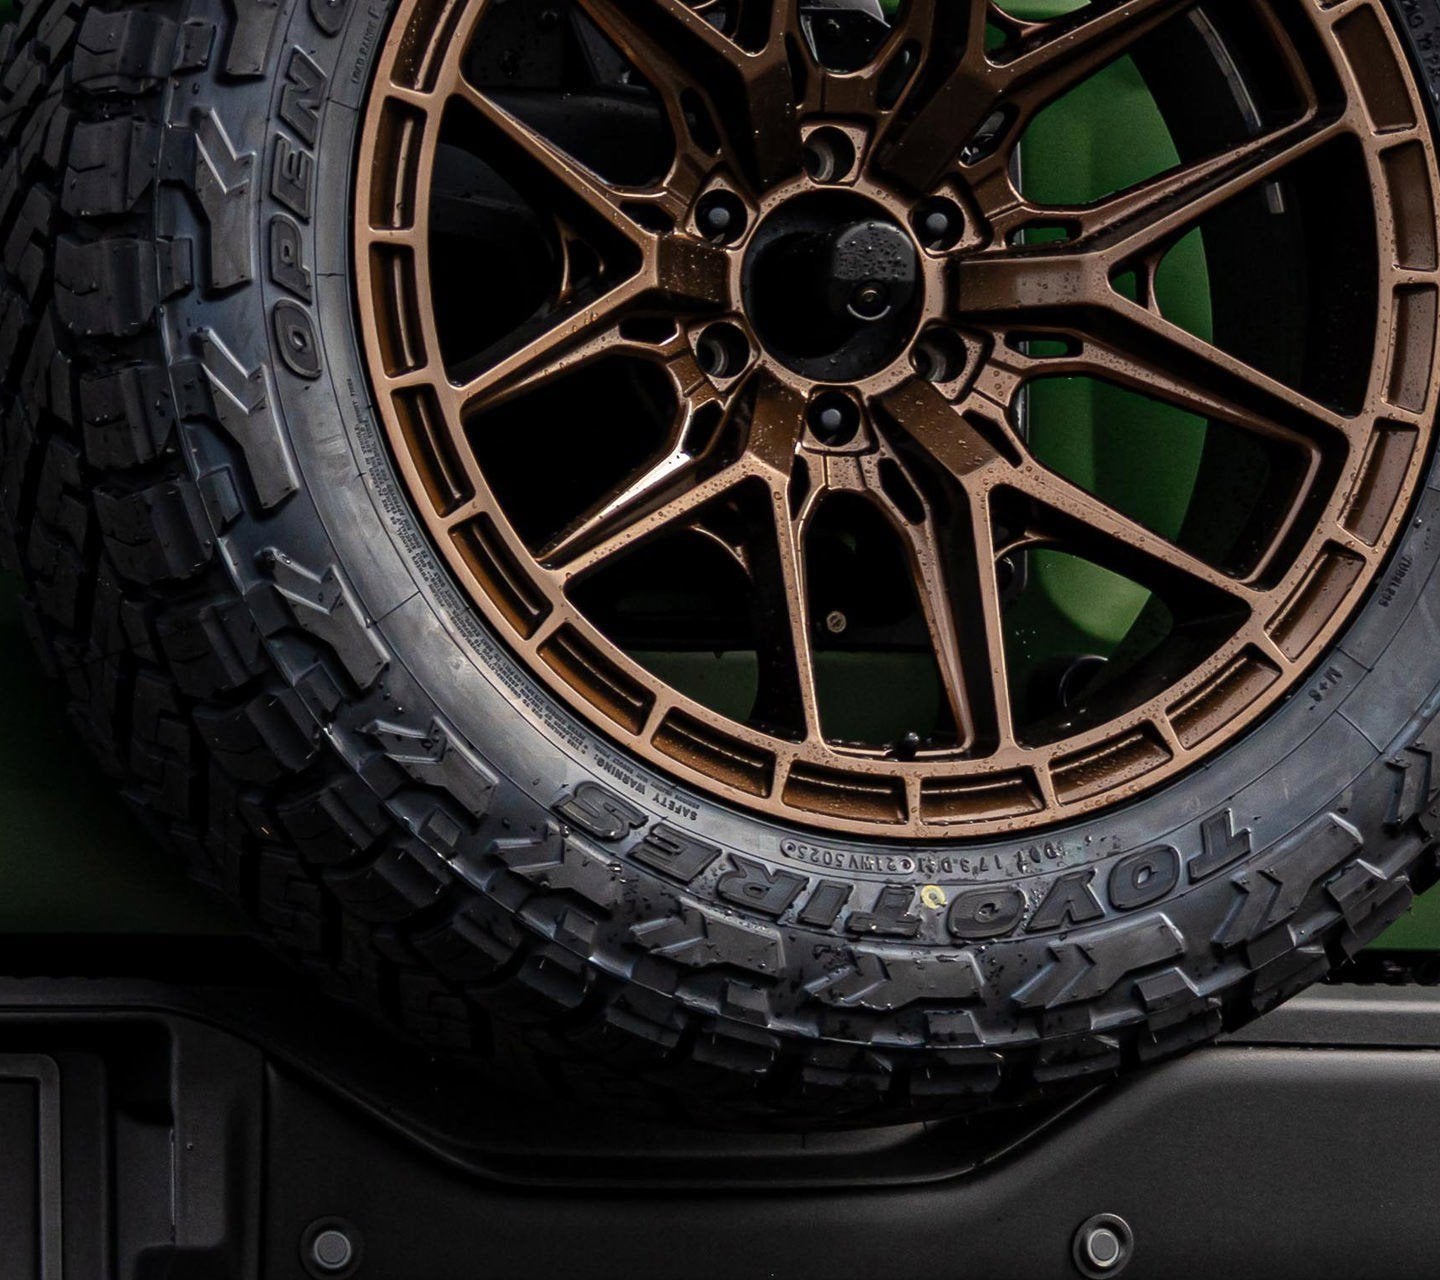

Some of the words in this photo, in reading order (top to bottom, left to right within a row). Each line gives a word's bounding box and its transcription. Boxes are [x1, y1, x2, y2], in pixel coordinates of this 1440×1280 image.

[265, 48, 328, 383] OPEN
[1305, 664, 1343, 705] M+S
[591, 753, 647, 795] WARNING:
[651, 792, 697, 821] SAFETY
[552, 776, 923, 939] TIRES
[946, 804, 1258, 942] TOYO
